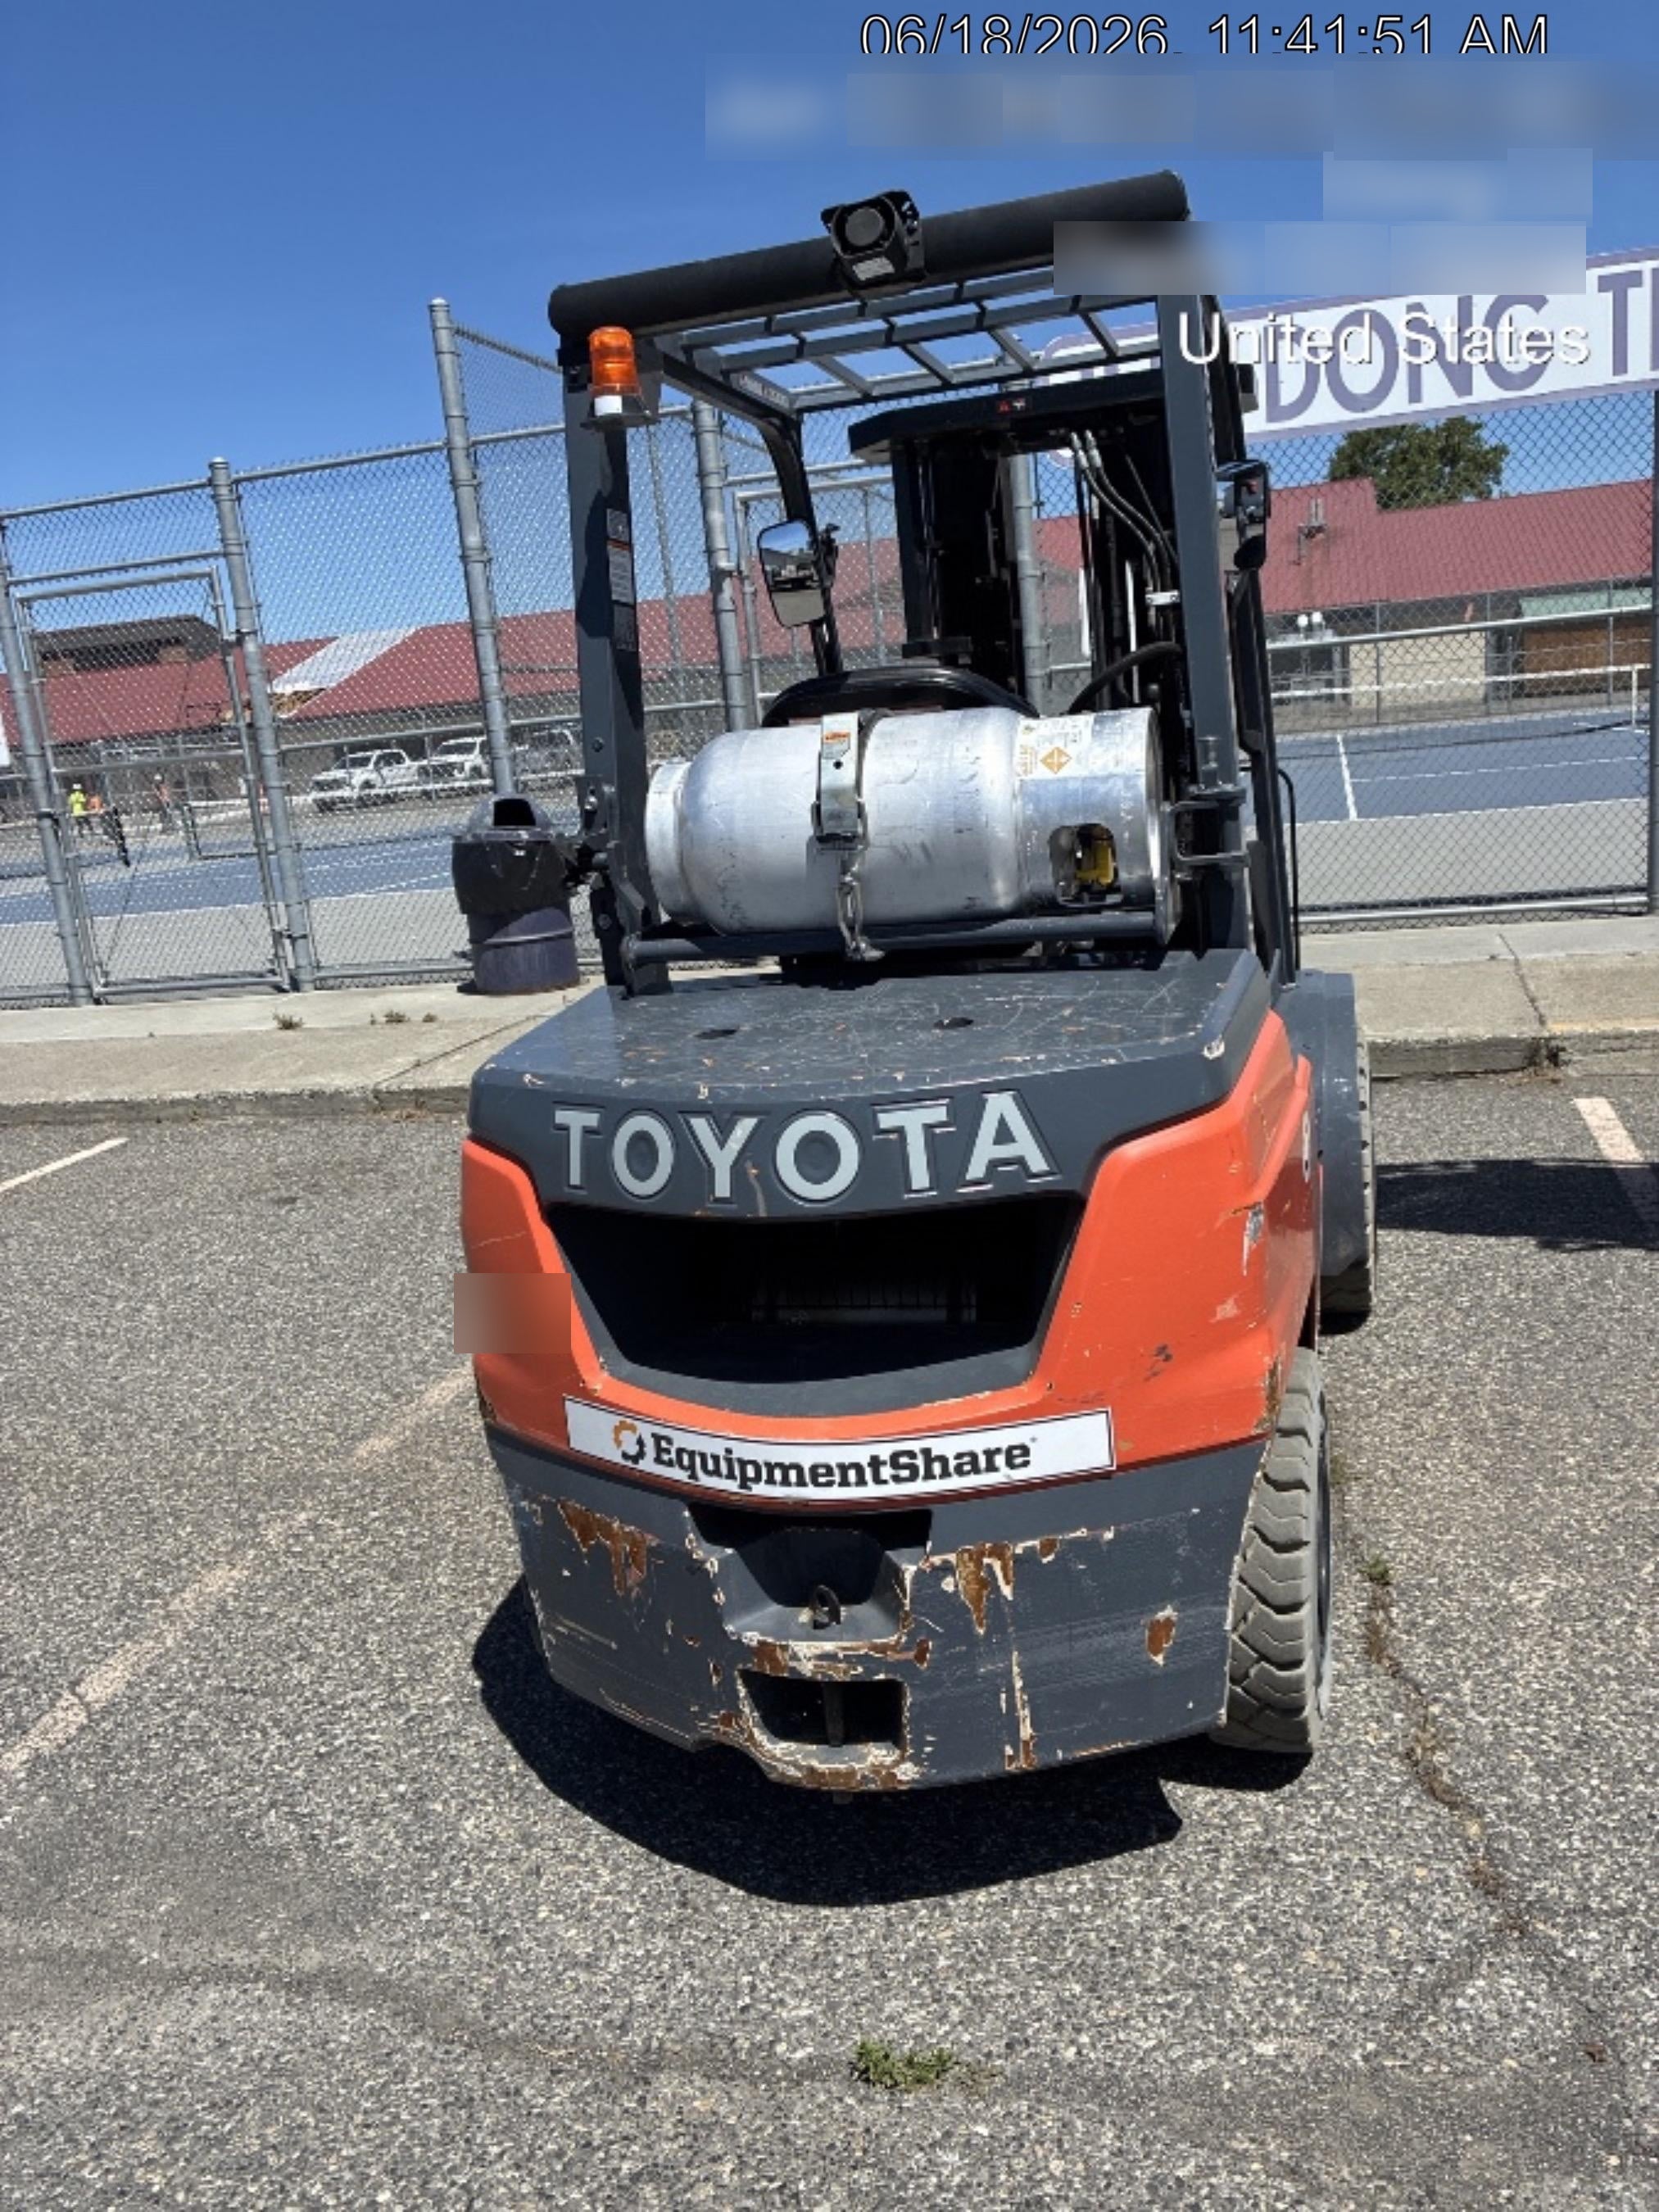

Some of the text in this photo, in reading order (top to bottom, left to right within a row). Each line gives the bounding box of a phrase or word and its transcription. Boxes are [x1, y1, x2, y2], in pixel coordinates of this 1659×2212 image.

[1598, 267, 1659, 377] T
[554, 1090, 1054, 1202] TOYOTA
[651, 1431, 1031, 1491] EquipmentShare
